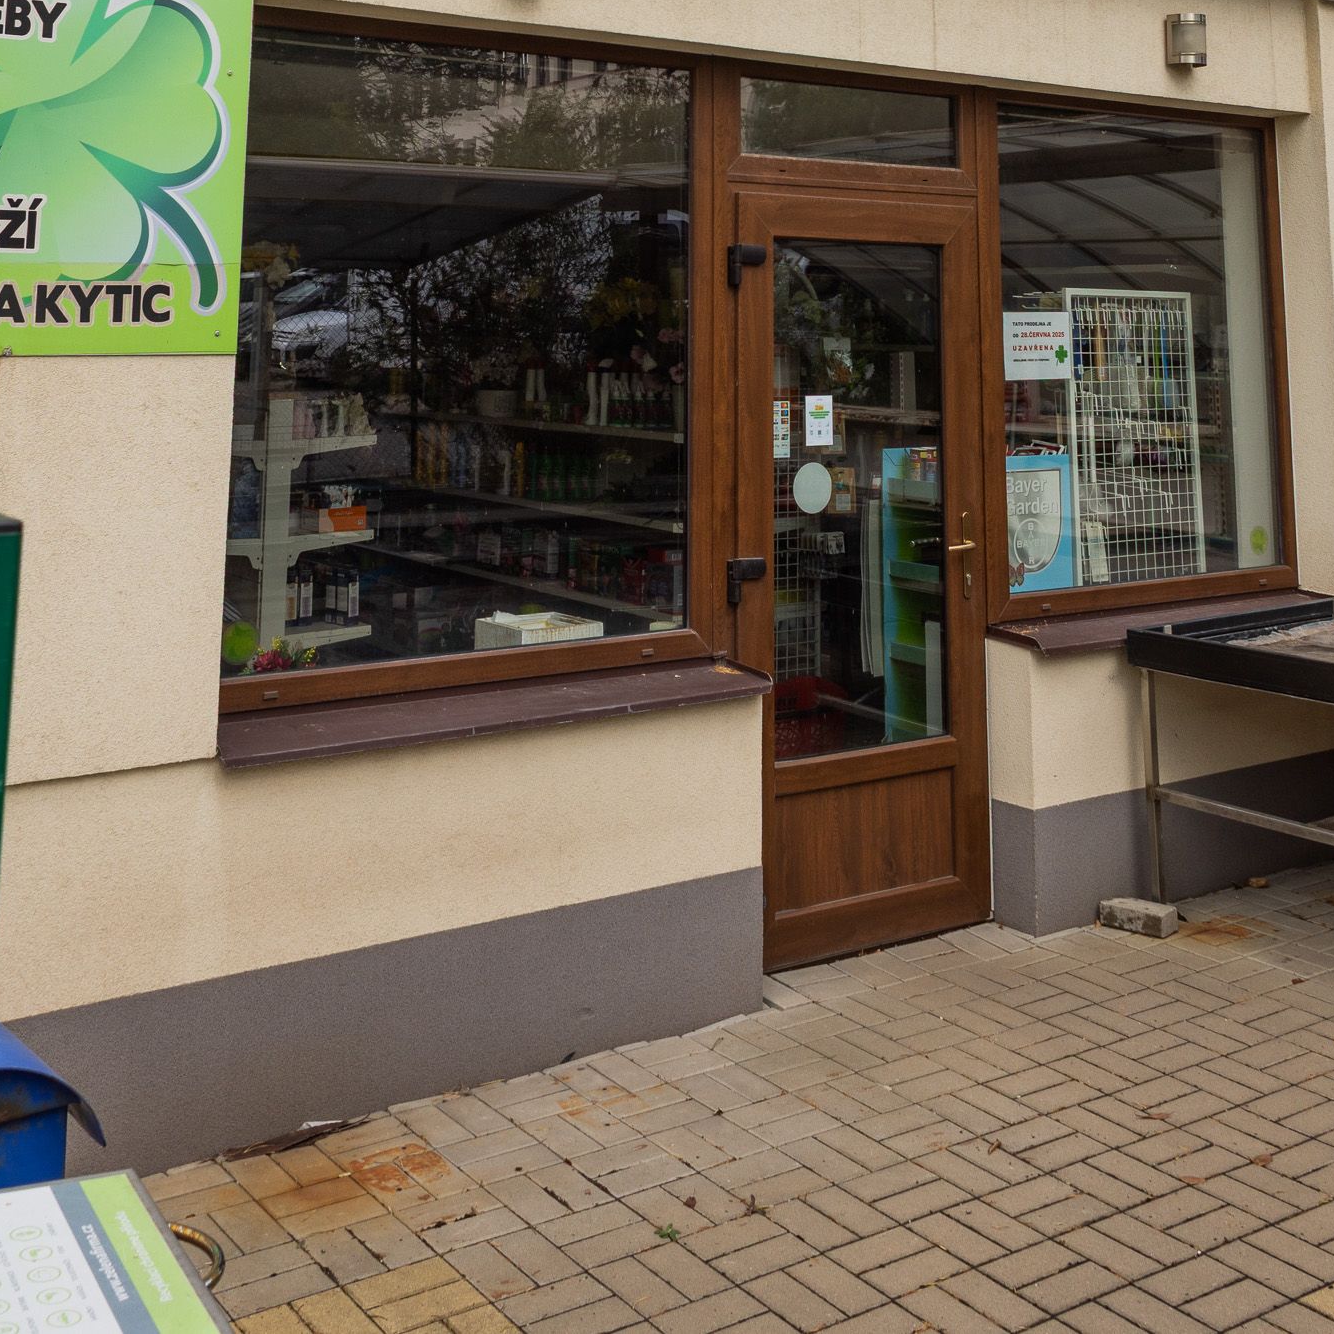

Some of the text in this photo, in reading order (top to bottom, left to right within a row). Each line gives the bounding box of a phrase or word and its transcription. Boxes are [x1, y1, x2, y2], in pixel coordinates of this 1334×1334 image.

[35, 284, 171, 323] KYTIC
[1006, 476, 1047, 496] Bayer
[1007, 497, 1059, 516] Garden
